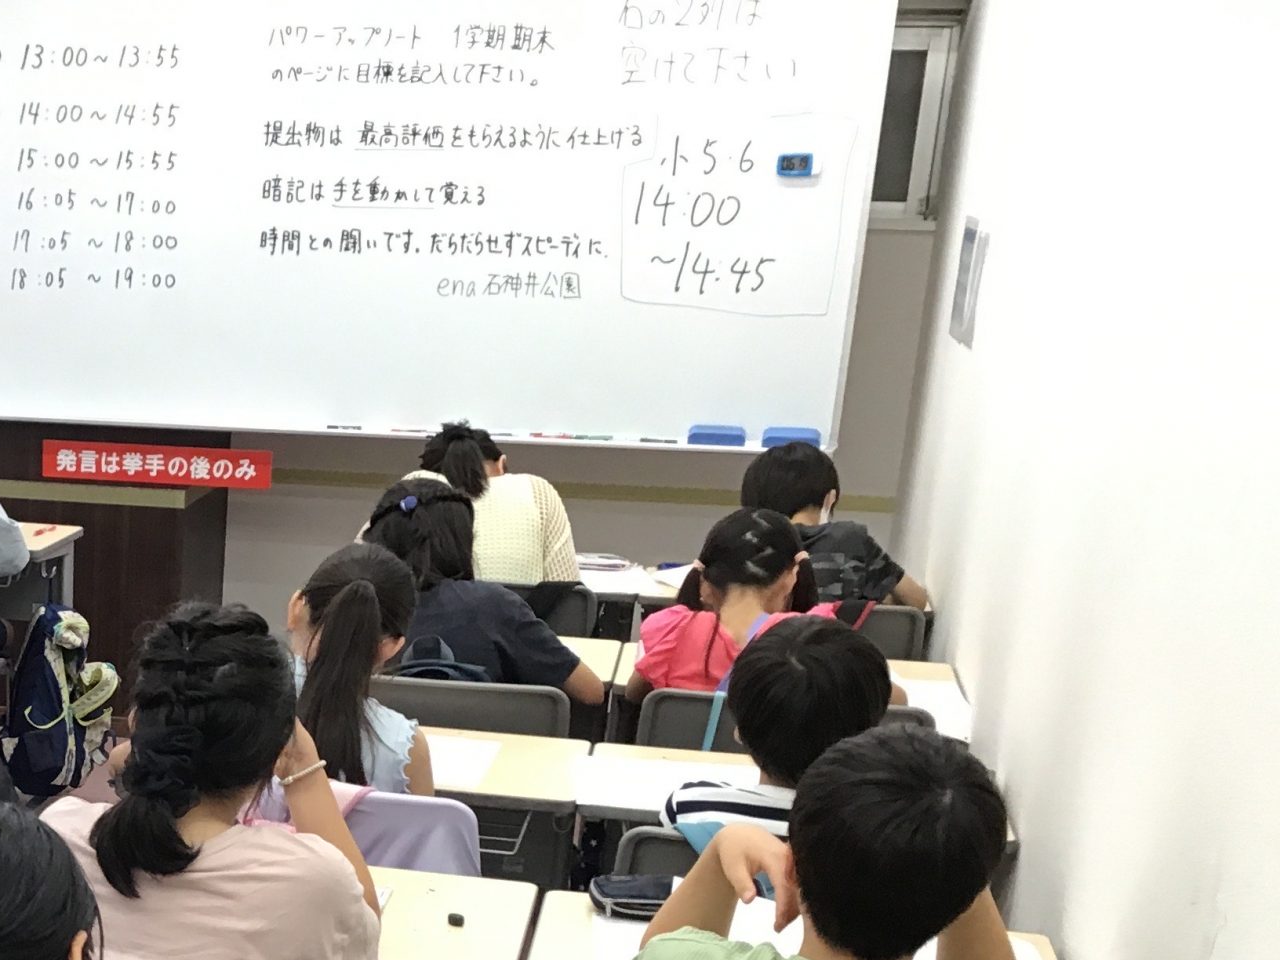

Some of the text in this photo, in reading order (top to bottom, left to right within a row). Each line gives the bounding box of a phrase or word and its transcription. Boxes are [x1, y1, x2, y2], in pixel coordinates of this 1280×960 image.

[634, 181, 741, 227] 14:00
[56, 449, 257, 480] 発言は挙手の後のみ
